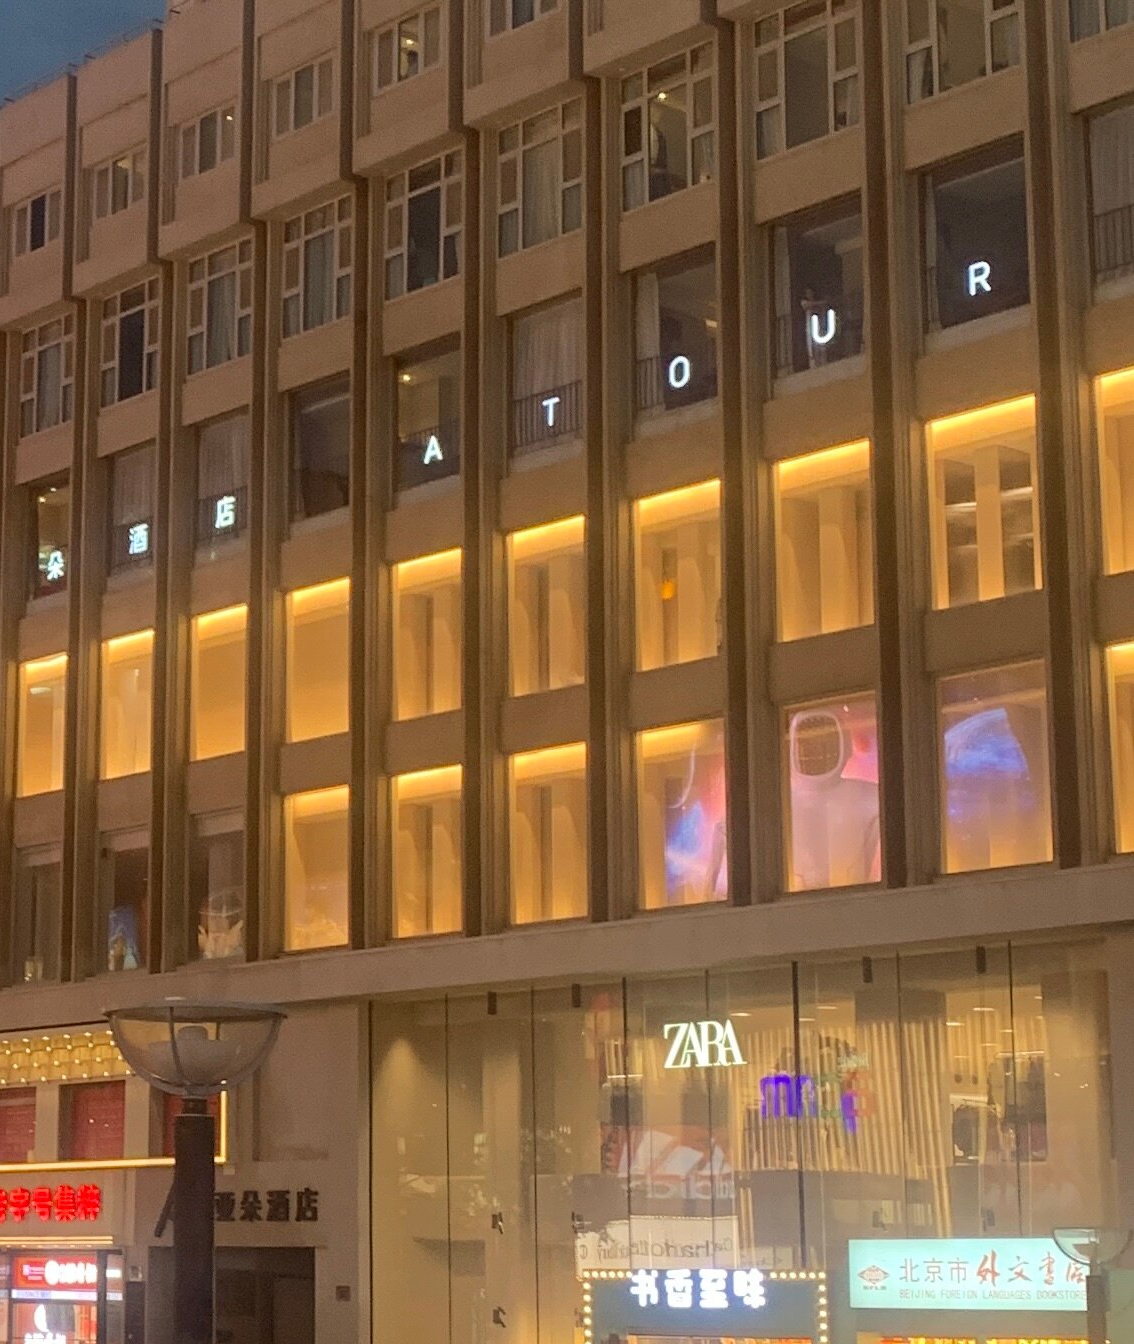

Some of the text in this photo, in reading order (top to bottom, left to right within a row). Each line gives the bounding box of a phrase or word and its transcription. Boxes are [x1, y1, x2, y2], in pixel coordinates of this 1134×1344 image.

[663, 1019, 747, 1068] ZARA
[899, 1288, 936, 1300] BEIJING
[941, 1288, 978, 1300] FOREIGN
[982, 1288, 1031, 1301] LANGUAGES
